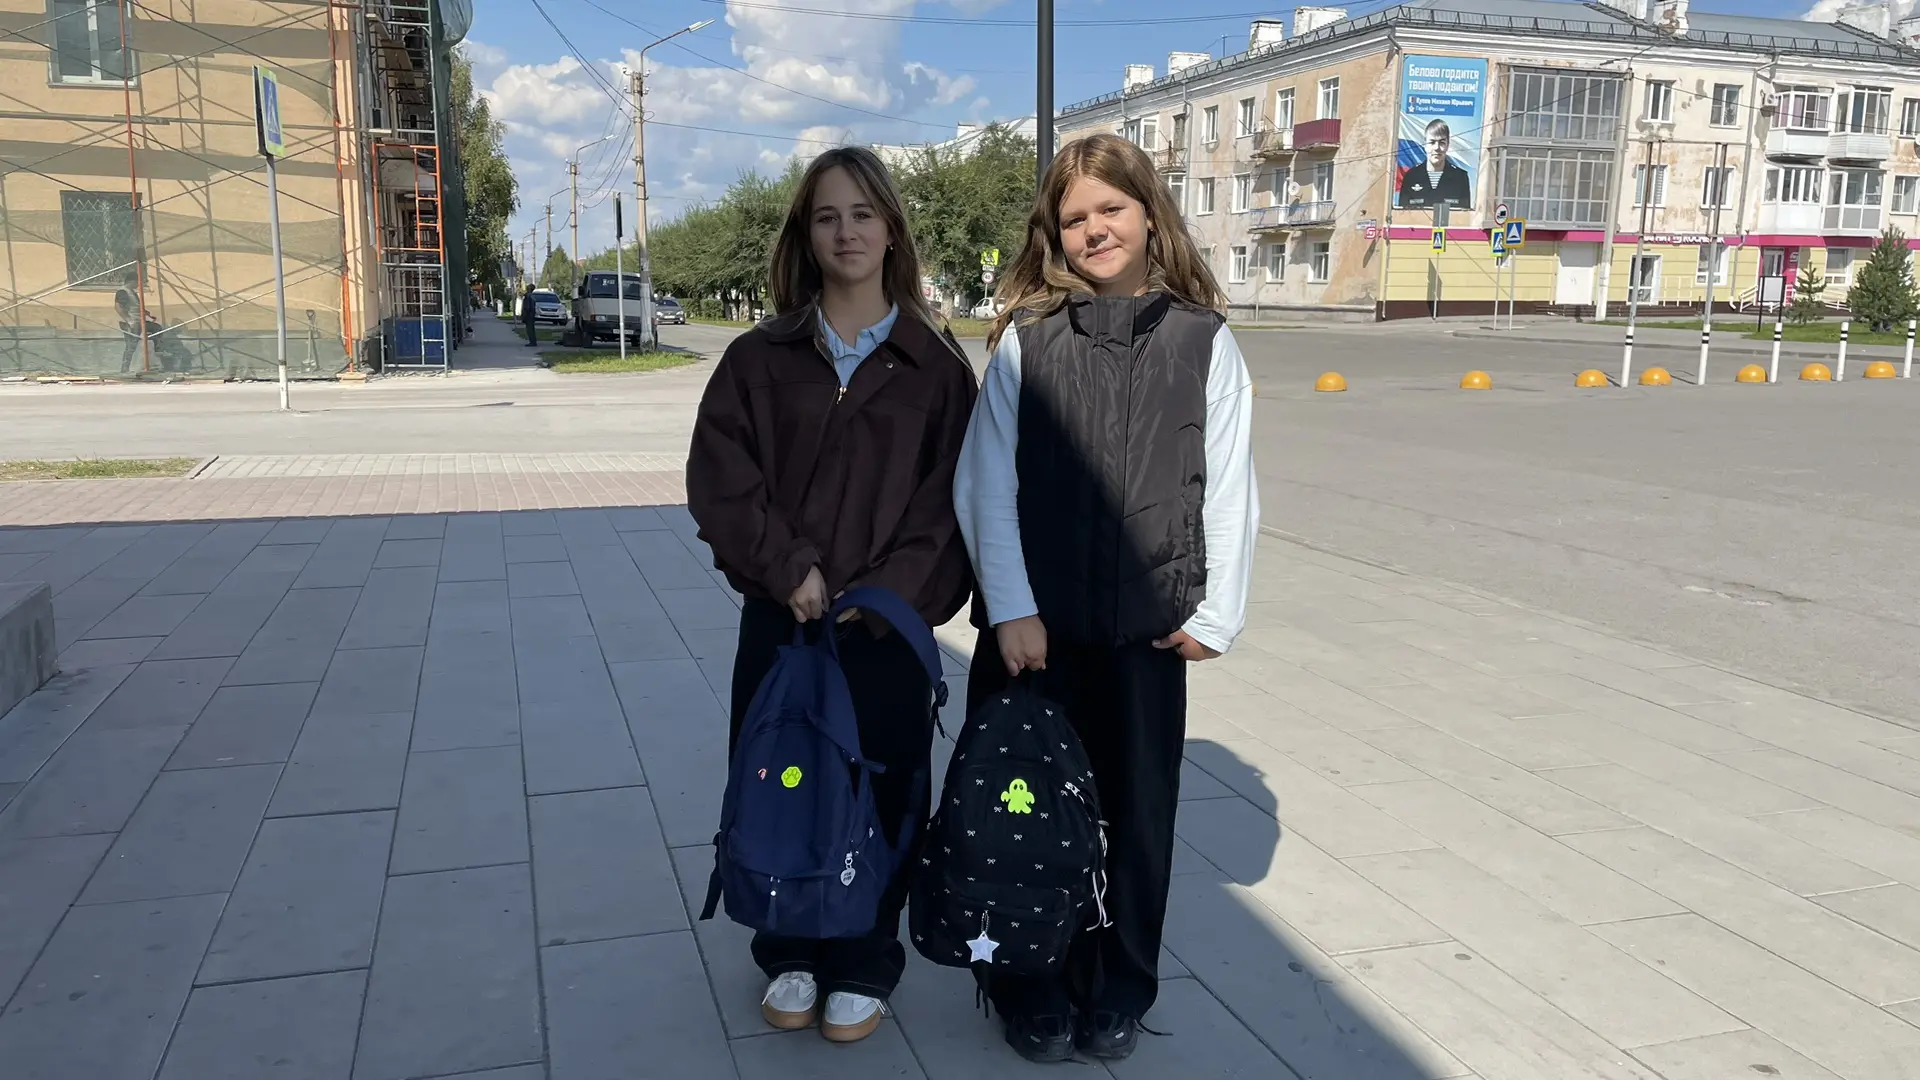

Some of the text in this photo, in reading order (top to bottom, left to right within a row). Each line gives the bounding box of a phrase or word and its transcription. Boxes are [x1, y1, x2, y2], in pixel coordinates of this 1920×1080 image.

[1409, 64, 1479, 81] Белово гордится
[1408, 80, 1479, 93] твоим подвигом!
